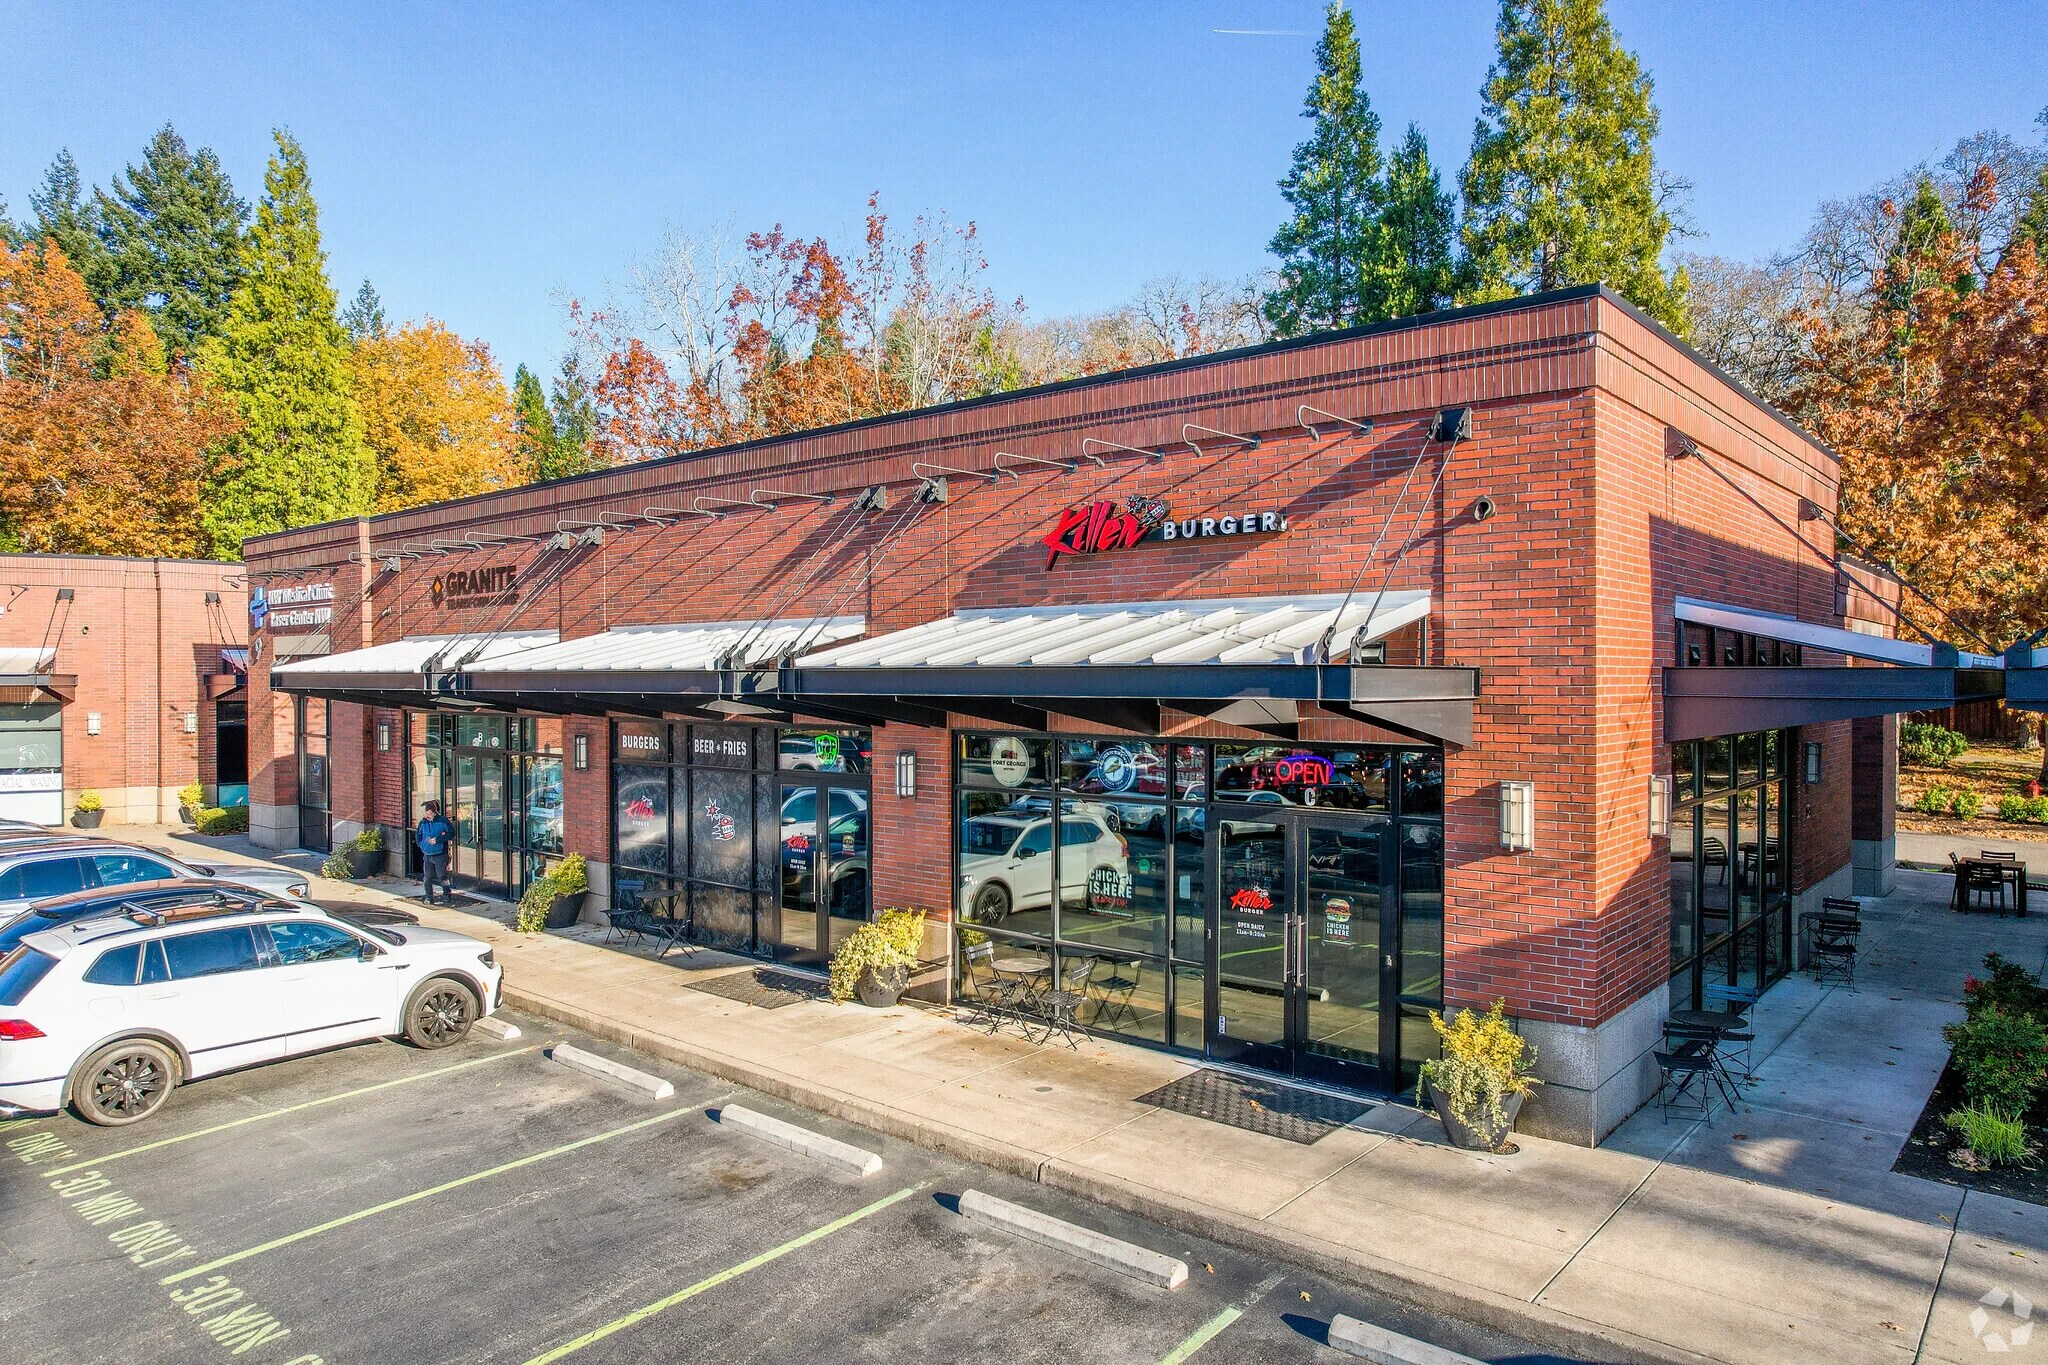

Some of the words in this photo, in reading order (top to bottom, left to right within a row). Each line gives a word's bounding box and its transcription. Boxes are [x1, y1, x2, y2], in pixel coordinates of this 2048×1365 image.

[1163, 511, 1278, 540] BURGER
[446, 565, 517, 597] GRANITE
[282, 585, 311, 604] Medical
[270, 612, 290, 627] Laser
[290, 610, 314, 626] Center
[622, 735, 660, 750] BURGERS
[694, 739, 714, 754] BEER
[723, 740, 747, 756] FRIES
[1275, 760, 1331, 785] OPEN
[1304, 787, 1316, 806] C
[1088, 880, 1101, 895] IS
[1102, 882, 1133, 899] HERE
[1239, 906, 1264, 916] BURGER
[1237, 921, 1250, 929] OPEN
[1250, 923, 1265, 931] DAILY
[1326, 922, 1350, 931] CHICKEN
[1326, 927, 1334, 935] IS
[1334, 928, 1350, 937] HERE
[50, 1170, 112, 1198] 30
[71, 1190, 145, 1226] MIN
[108, 1220, 197, 1268] ONLY
[169, 1275, 244, 1315] 30
[200, 1303, 291, 1355] MIN
